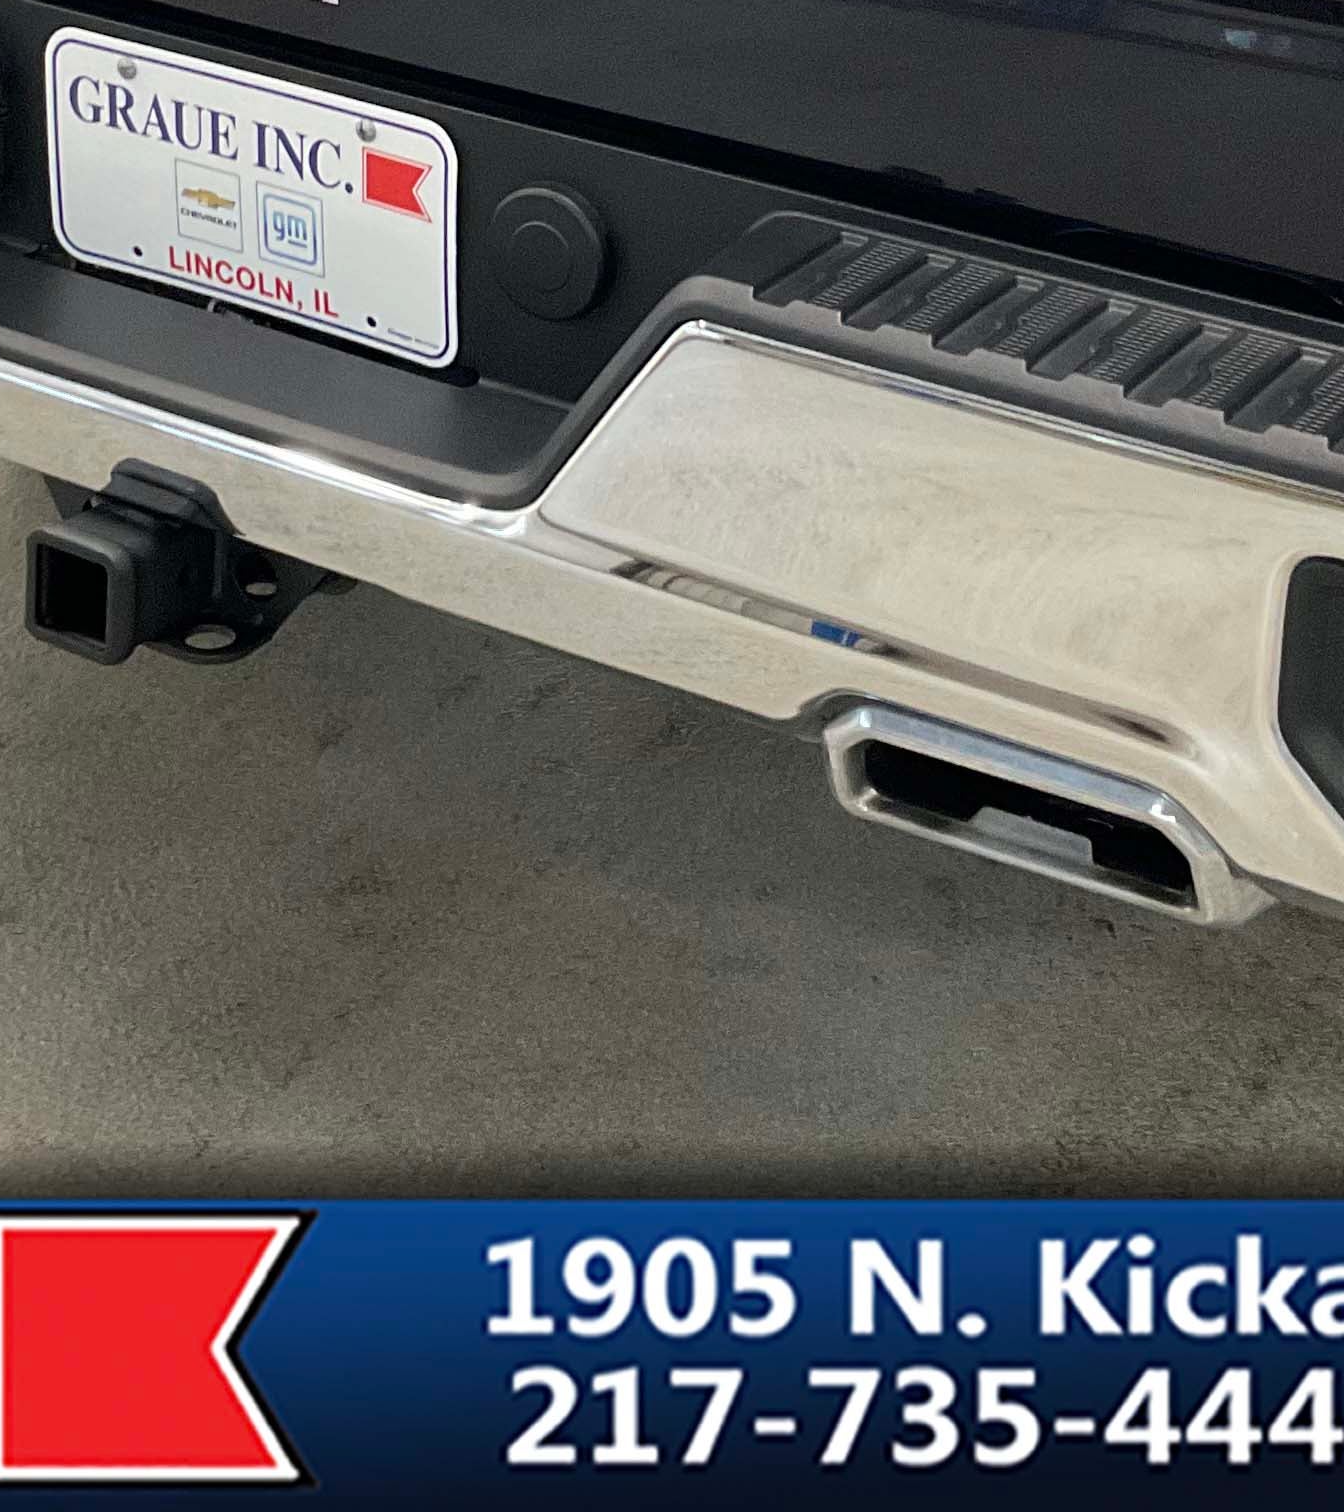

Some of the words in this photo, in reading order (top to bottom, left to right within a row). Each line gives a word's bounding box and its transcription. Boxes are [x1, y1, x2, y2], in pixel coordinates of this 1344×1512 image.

[67, 74, 240, 163] GRAUE
[252, 120, 354, 195] INC.
[179, 206, 238, 231] CHEVROLET
[272, 210, 308, 242] gm
[168, 245, 304, 311] LINCOLN,
[313, 287, 340, 318] IL
